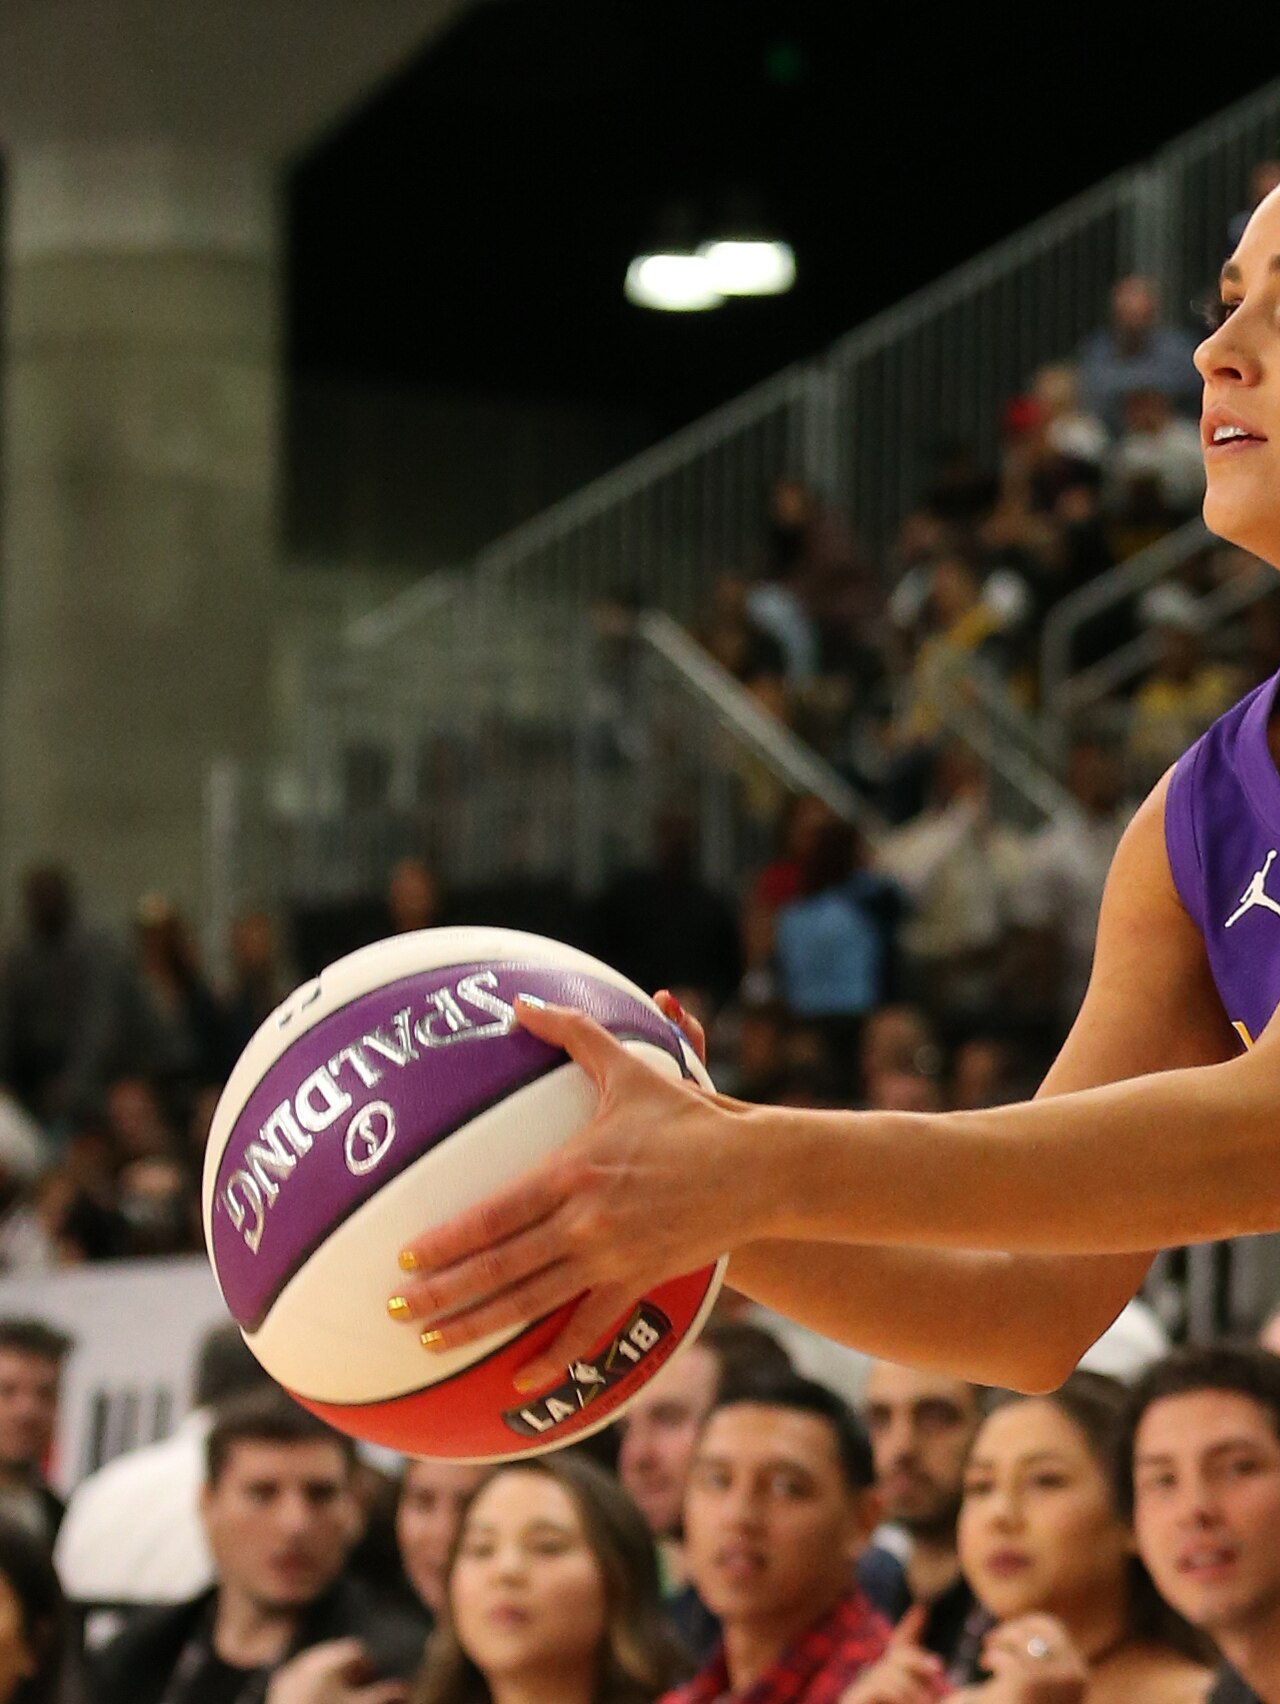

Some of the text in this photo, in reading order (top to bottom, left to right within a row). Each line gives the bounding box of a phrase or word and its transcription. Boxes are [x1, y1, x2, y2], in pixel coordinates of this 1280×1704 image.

[218, 970, 517, 1254] SPALDING
[520, 1318, 660, 1432] LA 18
